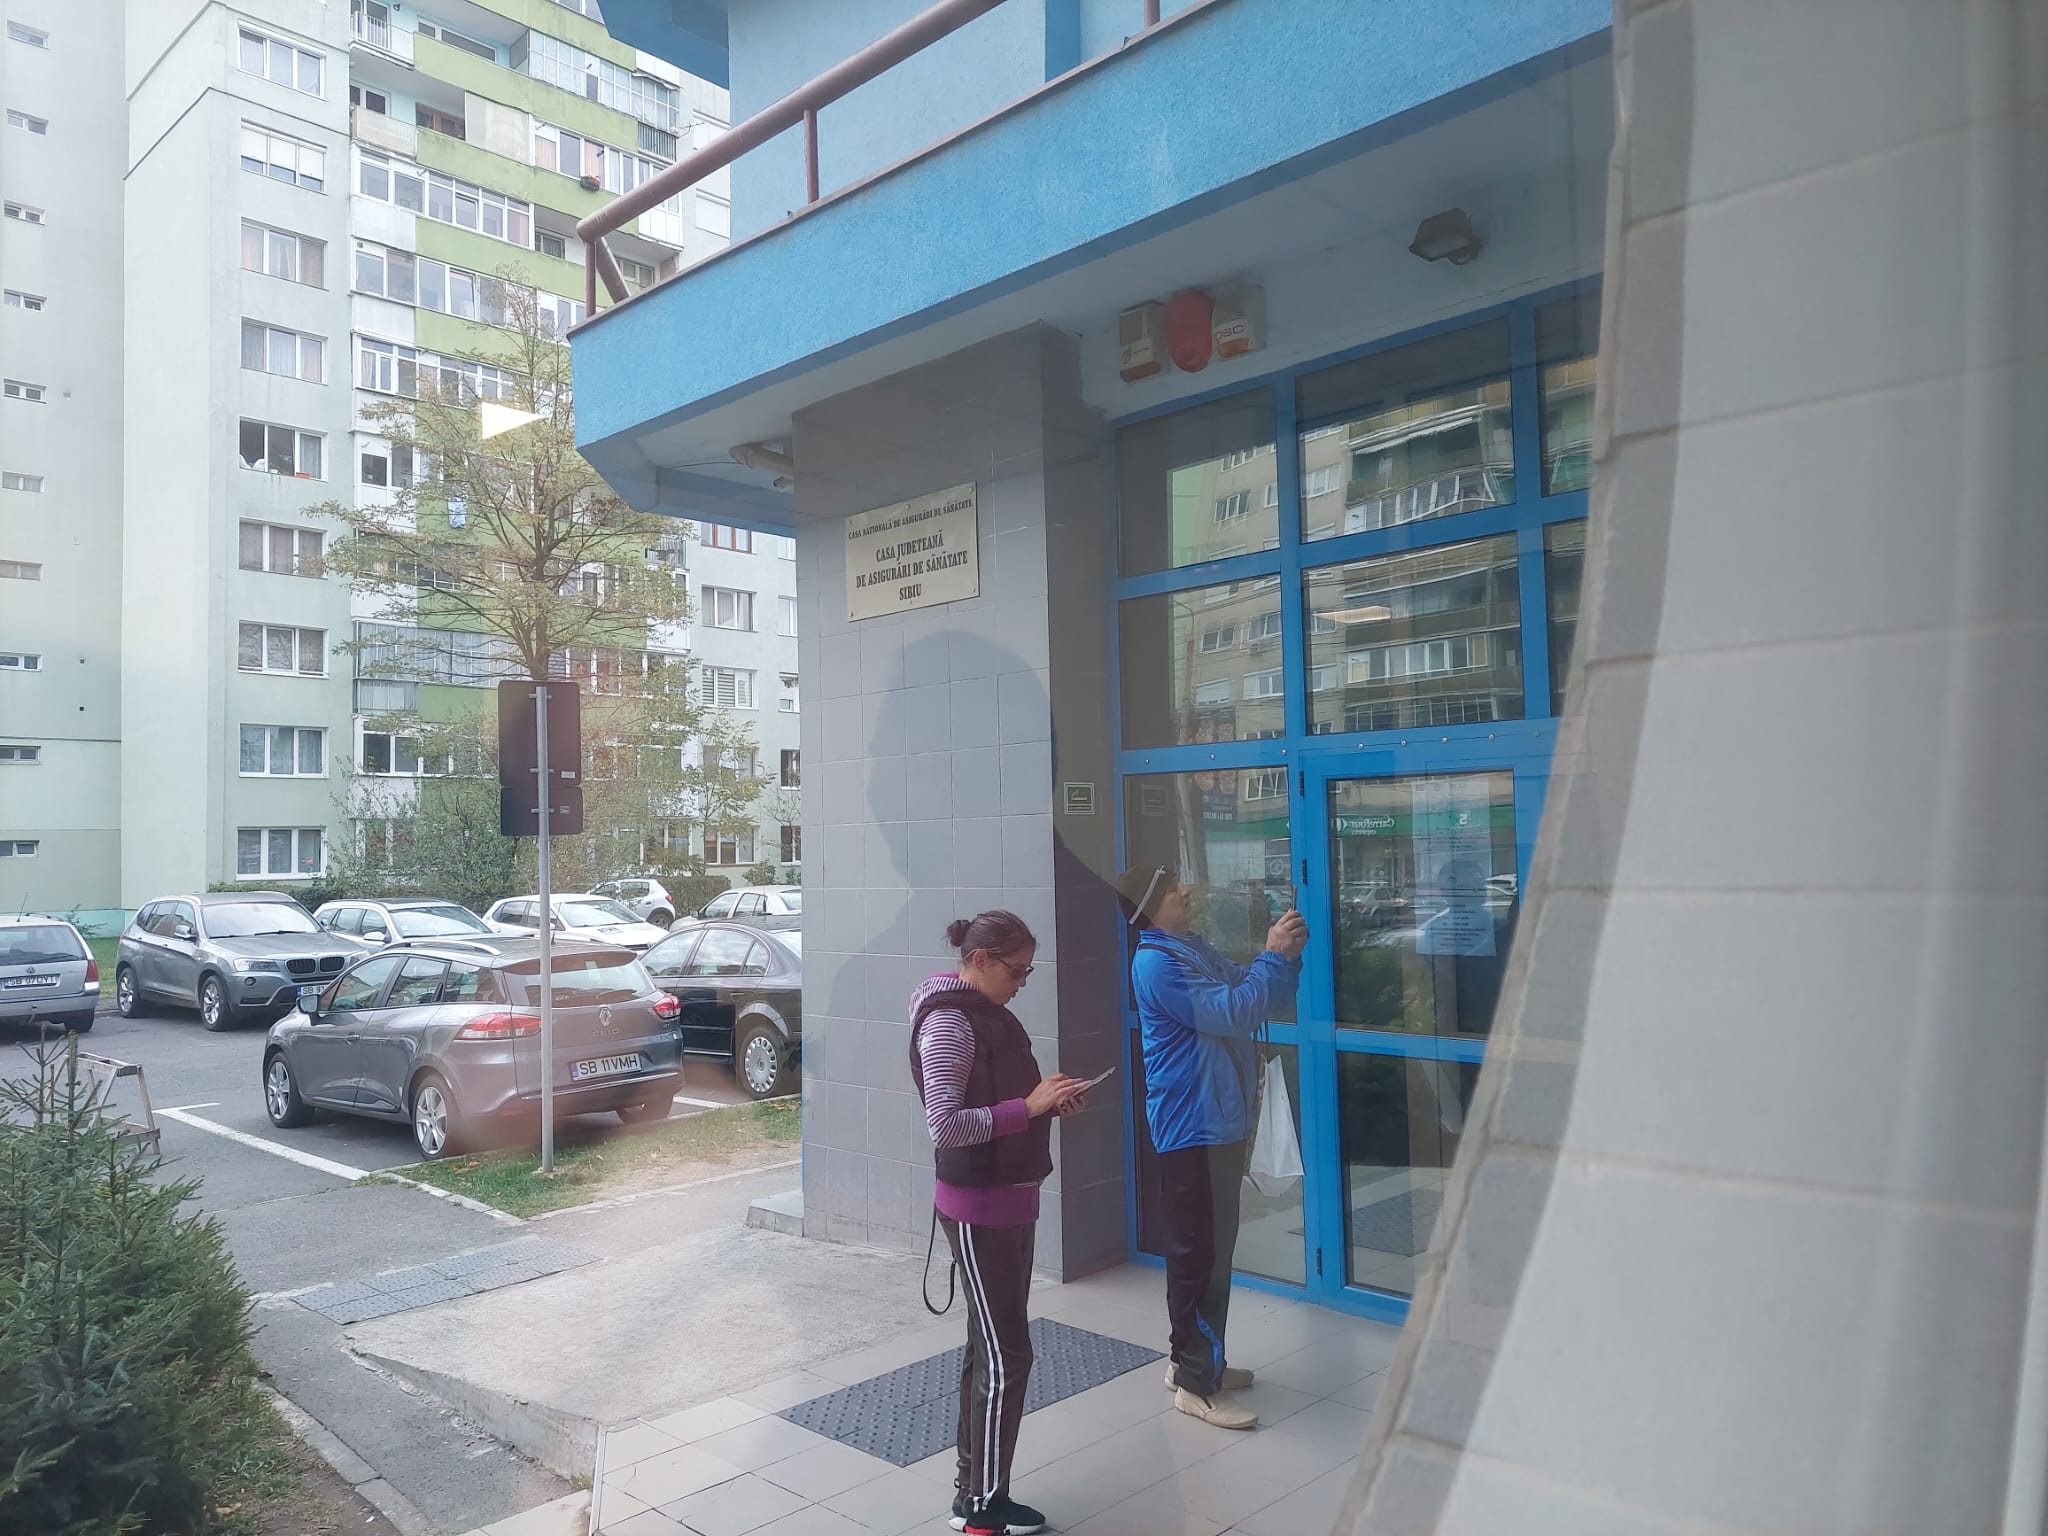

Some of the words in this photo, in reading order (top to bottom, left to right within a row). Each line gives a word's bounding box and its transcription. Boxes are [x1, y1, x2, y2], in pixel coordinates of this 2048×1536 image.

[848, 529, 862, 540] CASA
[893, 517, 901, 529] DE
[933, 507, 942, 518] DE
[876, 545, 896, 562] CASA
[856, 574, 867, 589] DE
[867, 562, 911, 586] ASIGURĂRI
[913, 560, 924, 576] DE
[926, 550, 968, 573] SĂNĂTATE
[899, 583, 922, 601] SIBIU
[579, 1062, 598, 1075] SB
[601, 1055, 638, 1072] 11VMH
